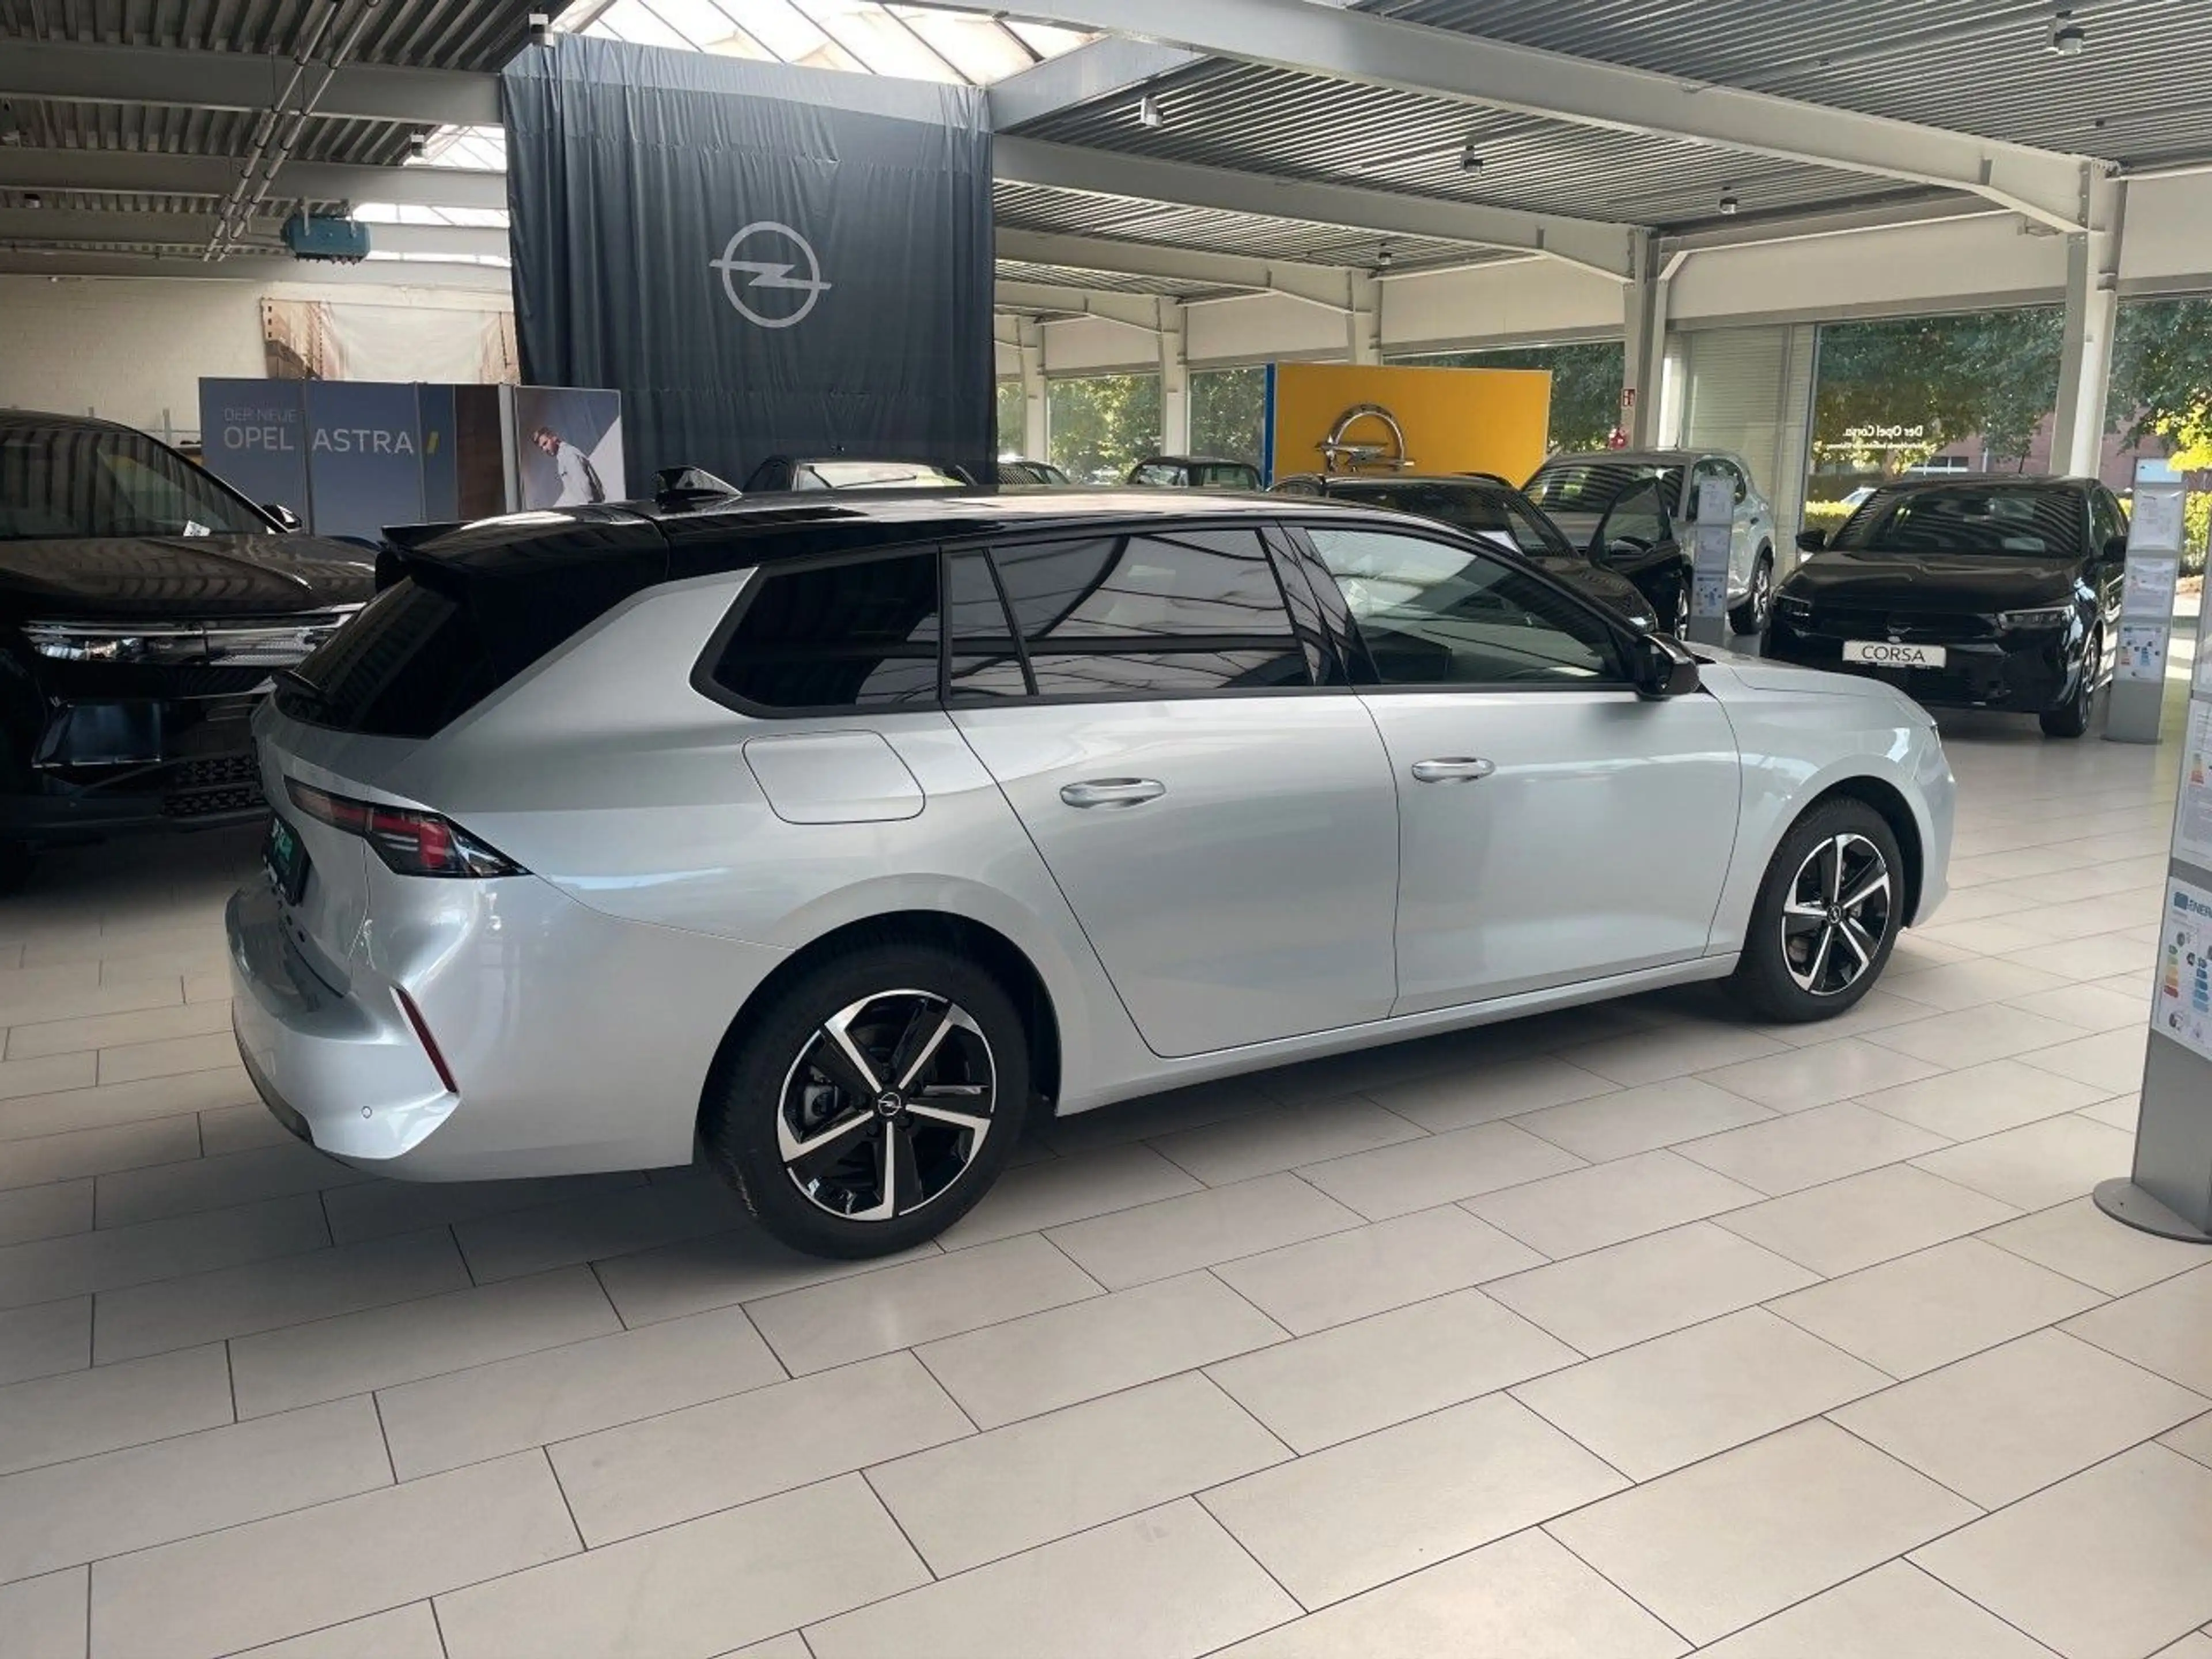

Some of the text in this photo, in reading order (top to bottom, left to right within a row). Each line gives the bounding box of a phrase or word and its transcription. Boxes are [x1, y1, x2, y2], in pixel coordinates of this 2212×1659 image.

[224, 426, 414, 453] OPEL ASTRA
[1862, 645, 1926, 662] CORSA
